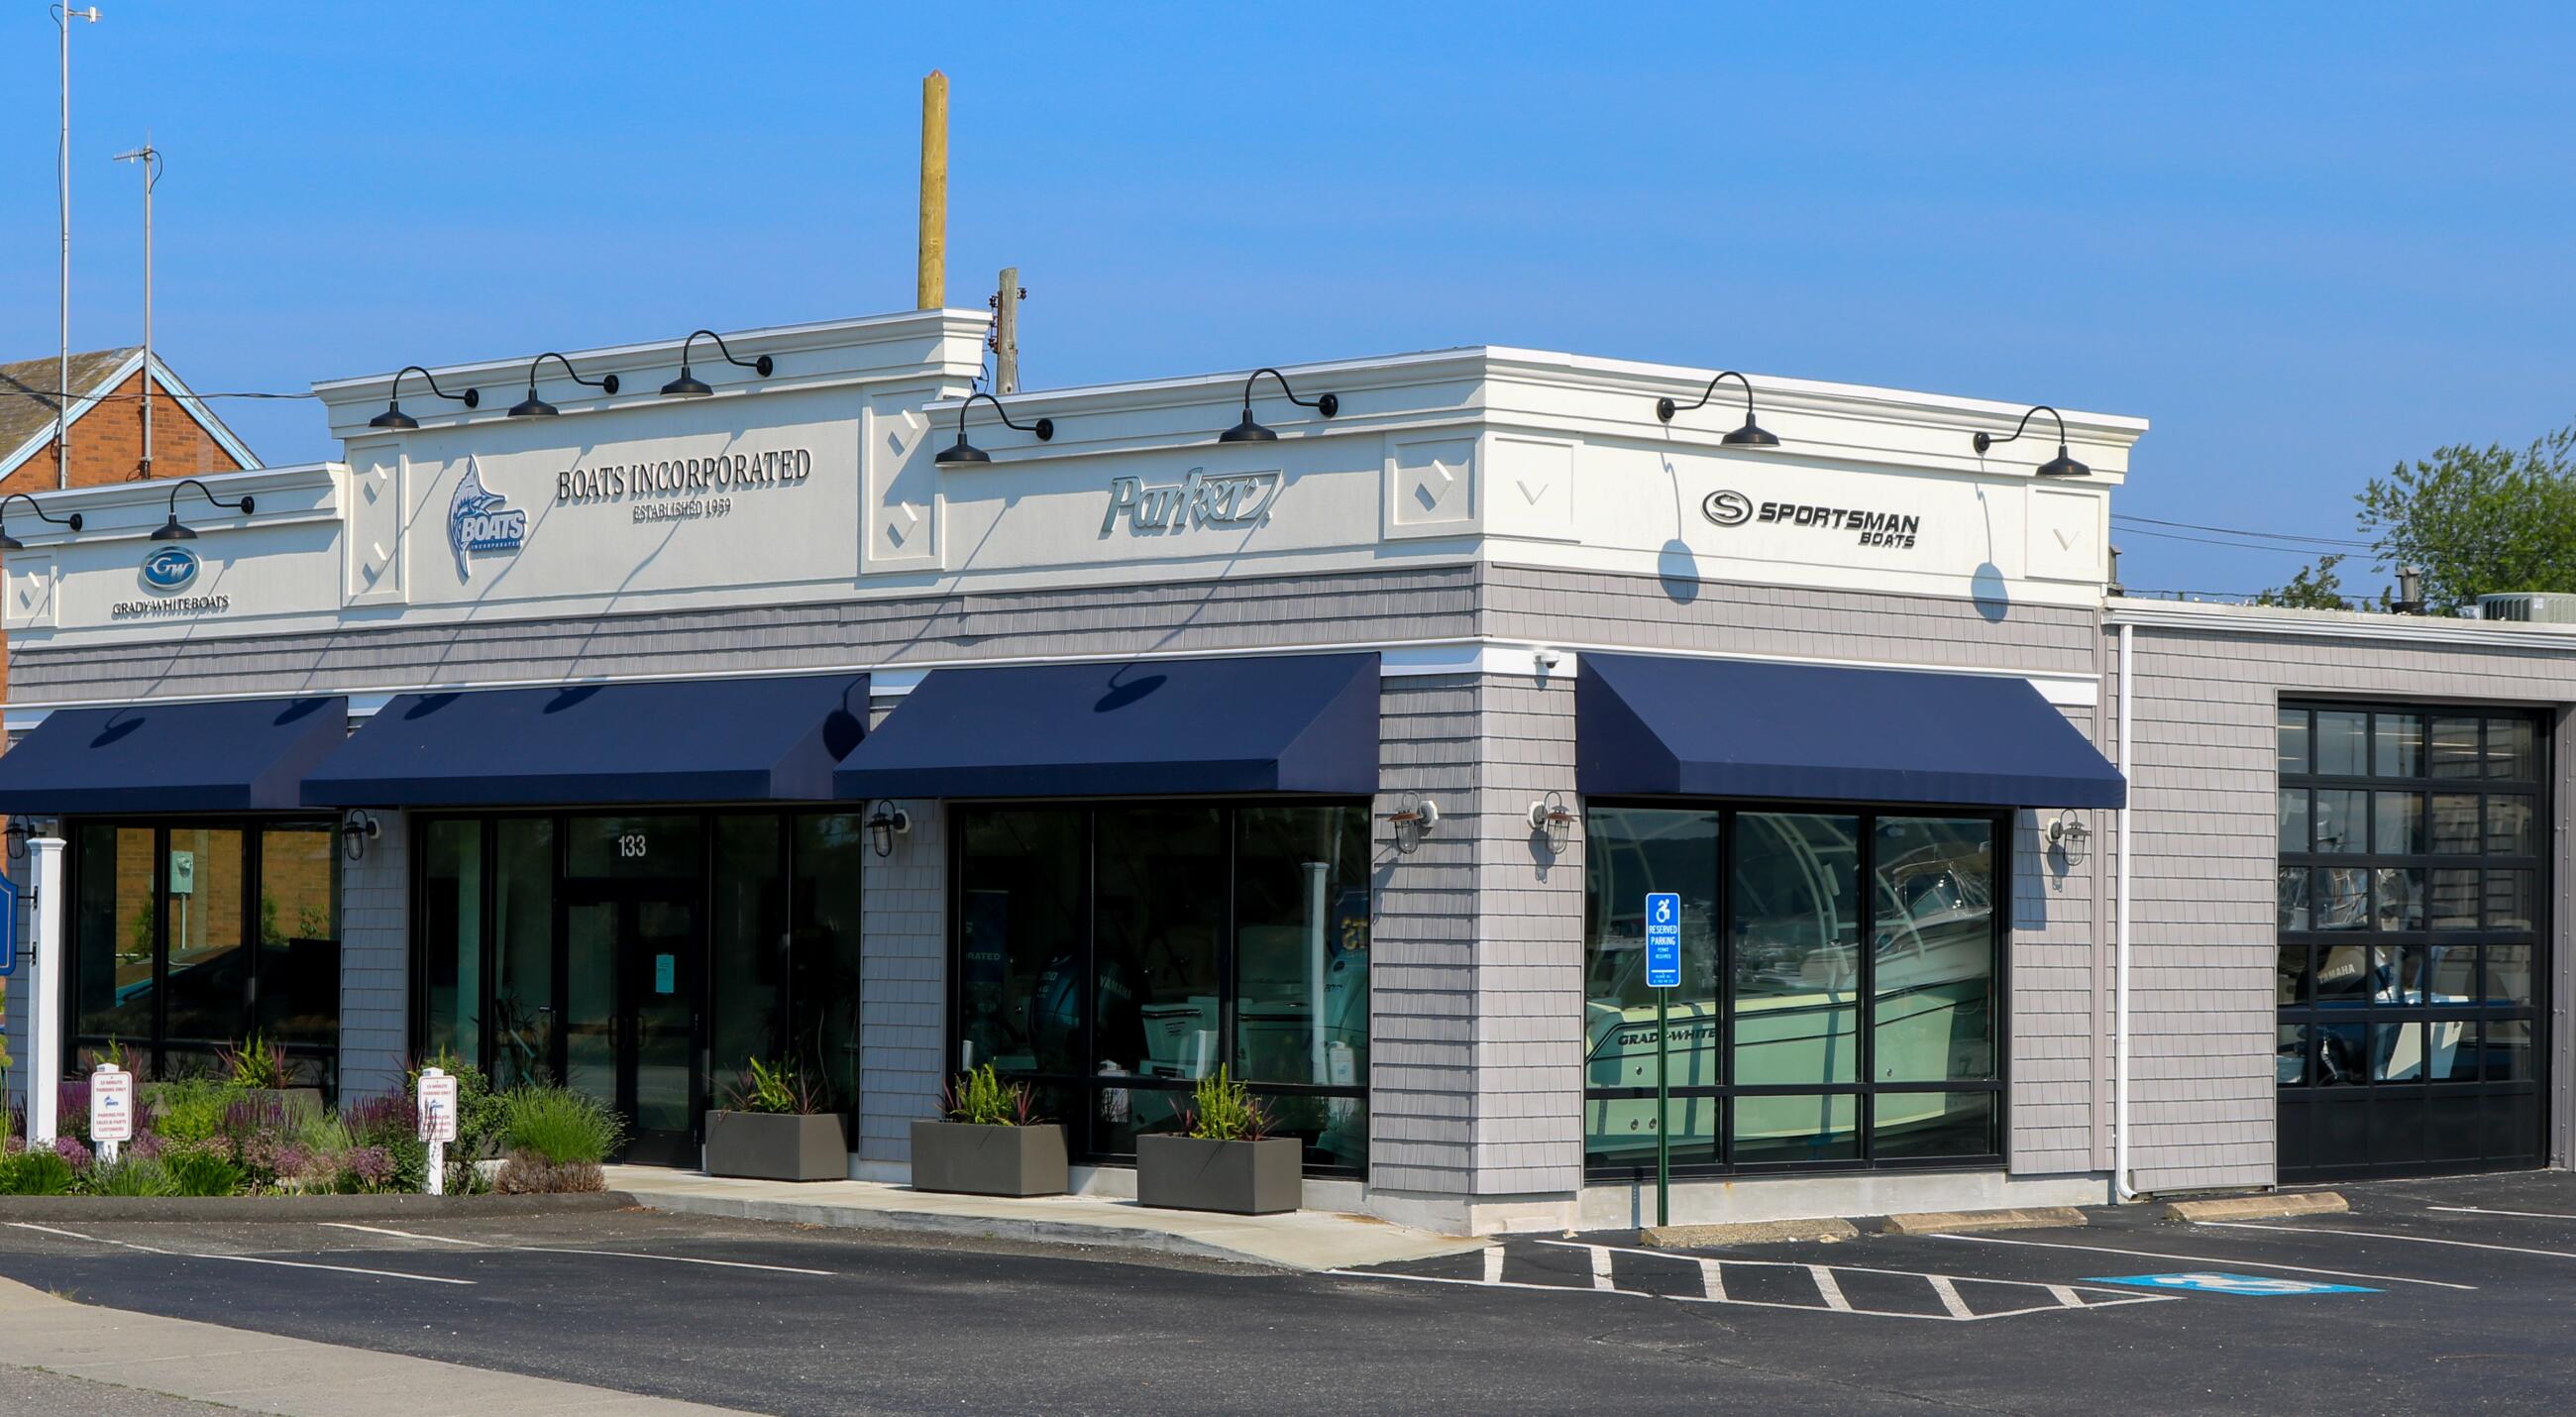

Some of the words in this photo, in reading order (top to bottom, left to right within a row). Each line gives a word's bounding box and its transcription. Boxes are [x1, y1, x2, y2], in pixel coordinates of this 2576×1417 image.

[558, 466, 625, 500] BOATS
[632, 448, 811, 493] INCORPORATED
[632, 499, 702, 521] ESTABLISHED
[705, 497, 731, 515] 1959
[1100, 467, 1272, 532] Parker
[461, 513, 525, 542] BOATS
[1758, 502, 1921, 533] SPORTSMAN
[1860, 532, 1916, 547] BOATS
[618, 834, 646, 857] 133
[1649, 925, 1677, 934] RESERVED
[1651, 936, 1676, 946] PARKING
[2317, 964, 2355, 984] YAMAHA
